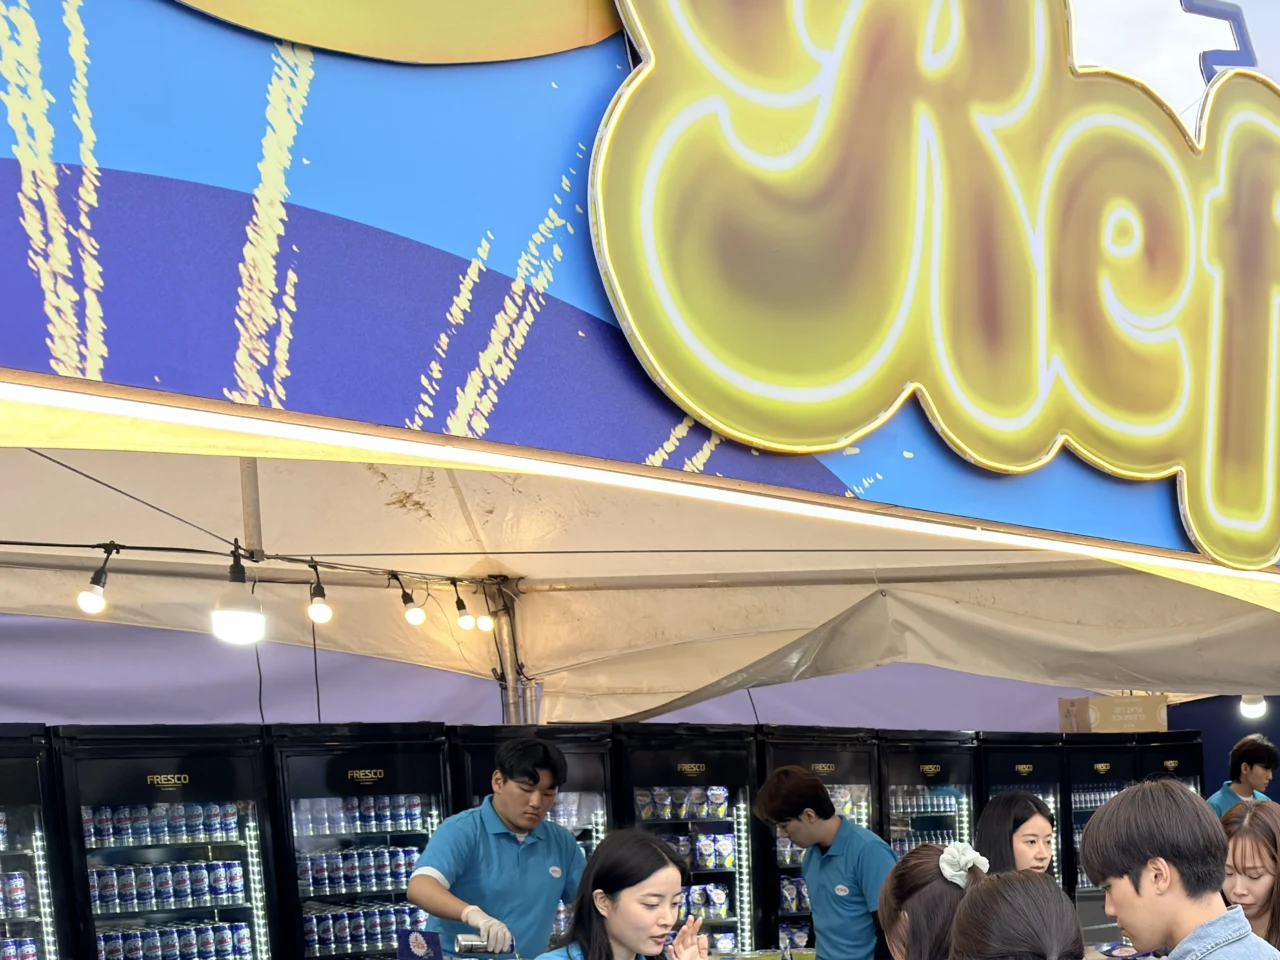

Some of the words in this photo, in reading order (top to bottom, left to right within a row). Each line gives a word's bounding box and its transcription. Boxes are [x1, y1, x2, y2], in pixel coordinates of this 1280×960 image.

[677, 763, 706, 772] FRESCO
[811, 763, 835, 771] FRESCO
[919, 764, 941, 772] FRESCO
[1015, 764, 1034, 772] FRESCO
[348, 769, 384, 779] FRESCO
[147, 774, 189, 785] FRESCO
